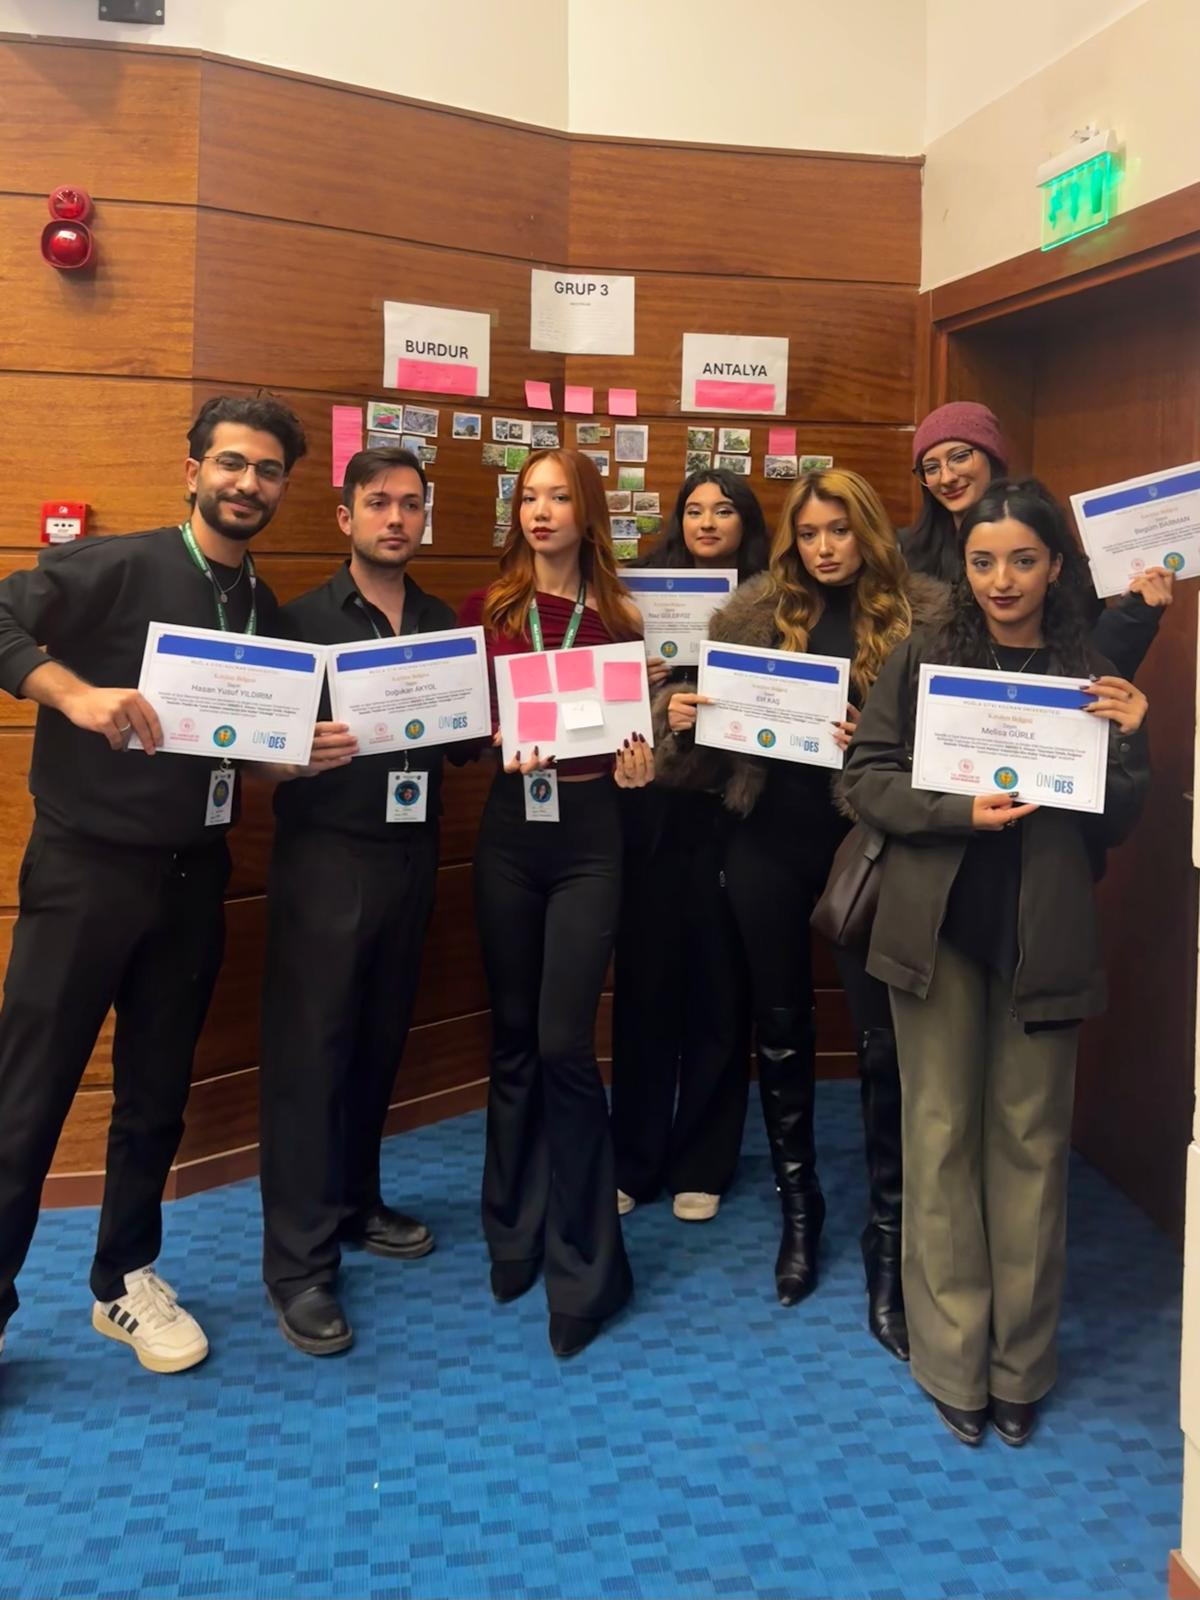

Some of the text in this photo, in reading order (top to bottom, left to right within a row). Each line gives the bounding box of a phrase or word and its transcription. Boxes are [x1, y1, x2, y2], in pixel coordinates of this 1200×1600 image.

[554, 281, 609, 296] GRUP 3
[405, 339, 469, 360] BURDUR
[702, 362, 768, 377] ANTALYA
[191, 684, 216, 694] Hasan
[217, 687, 240, 697] Yusuf
[981, 727, 1036, 740] Melisa GÜRLE
